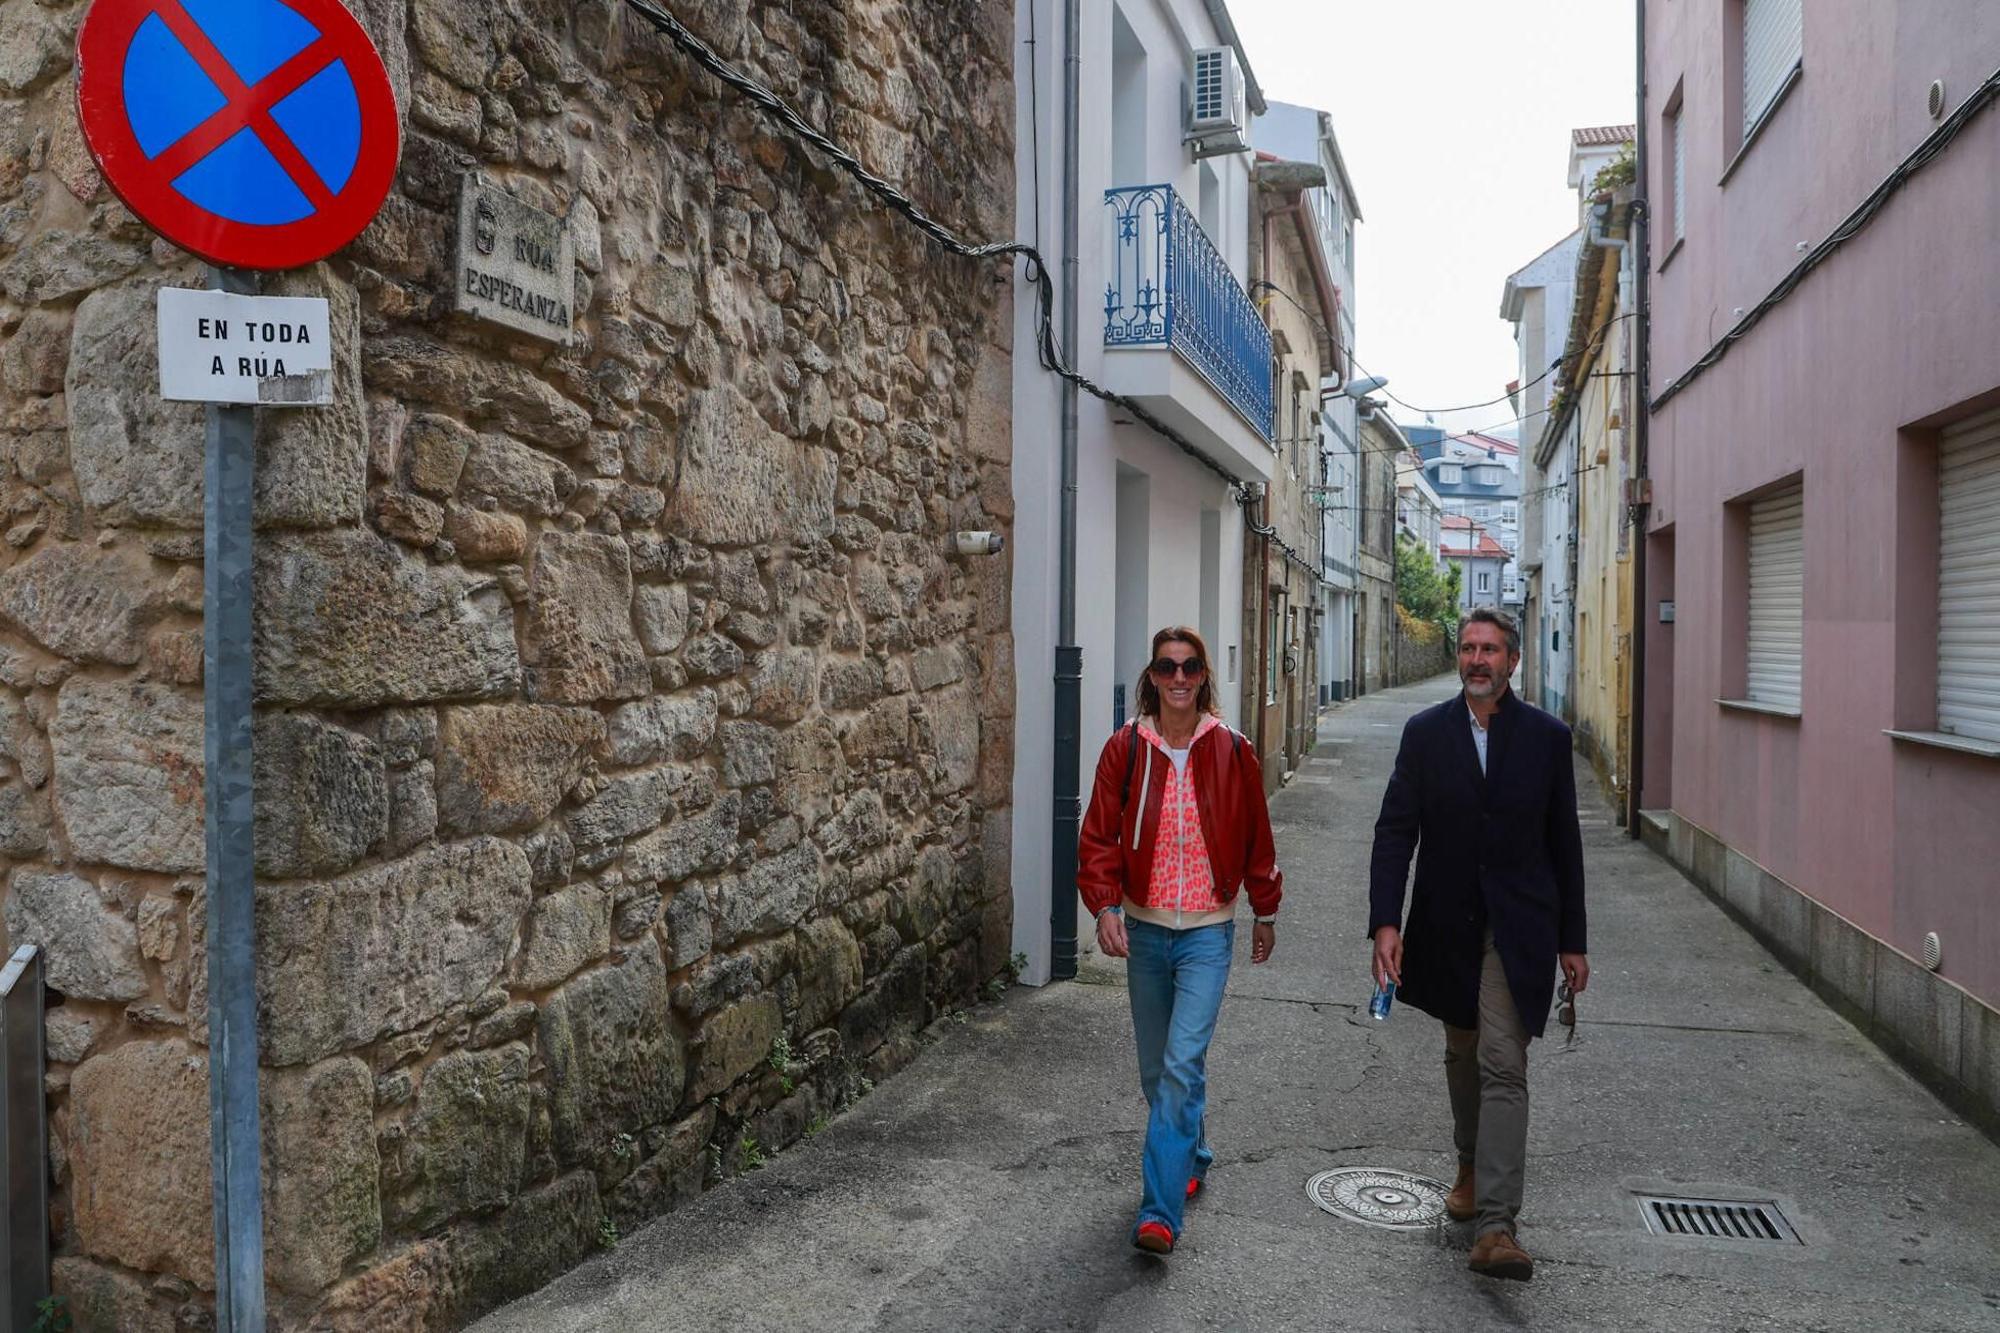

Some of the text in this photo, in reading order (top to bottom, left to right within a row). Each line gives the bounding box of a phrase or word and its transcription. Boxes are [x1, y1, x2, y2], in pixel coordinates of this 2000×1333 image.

[465, 267, 567, 328] ESPERANZA
[198, 318, 311, 344] EN TODA
[211, 350, 287, 377] A RÚA
